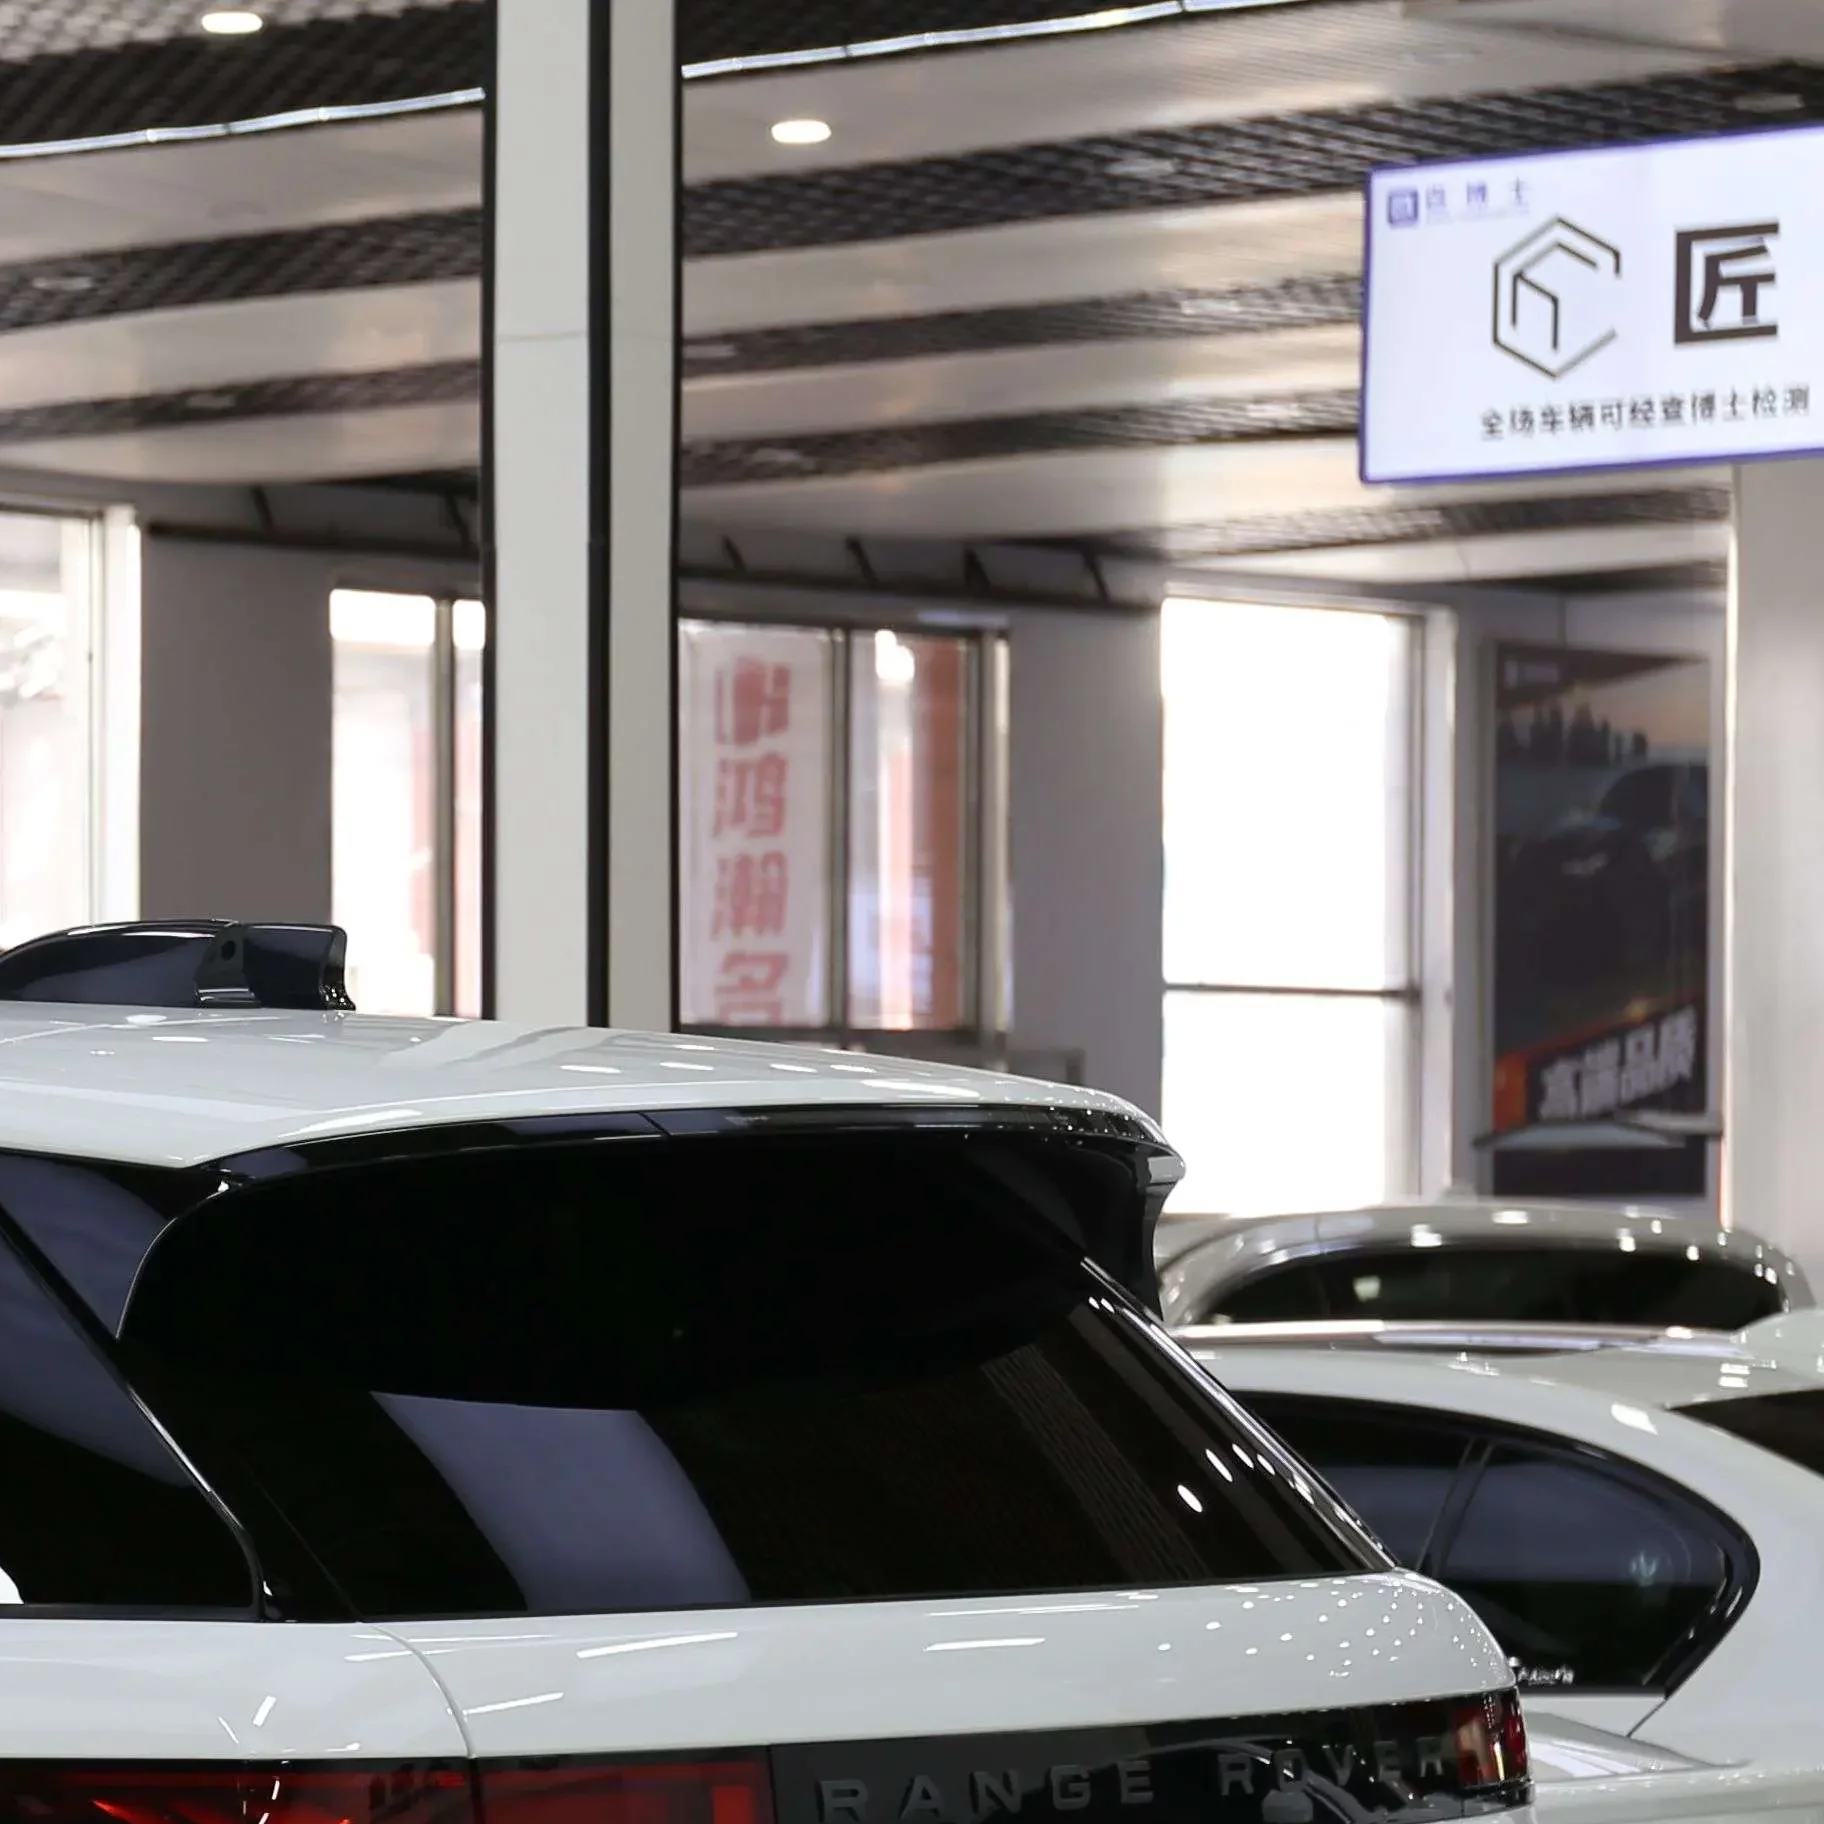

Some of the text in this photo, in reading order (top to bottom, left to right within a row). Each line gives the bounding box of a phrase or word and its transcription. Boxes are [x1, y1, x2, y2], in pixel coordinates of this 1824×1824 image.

[1674, 220, 1780, 347] 匠
[816, 1735, 1445, 1824] RANGE ROVER
